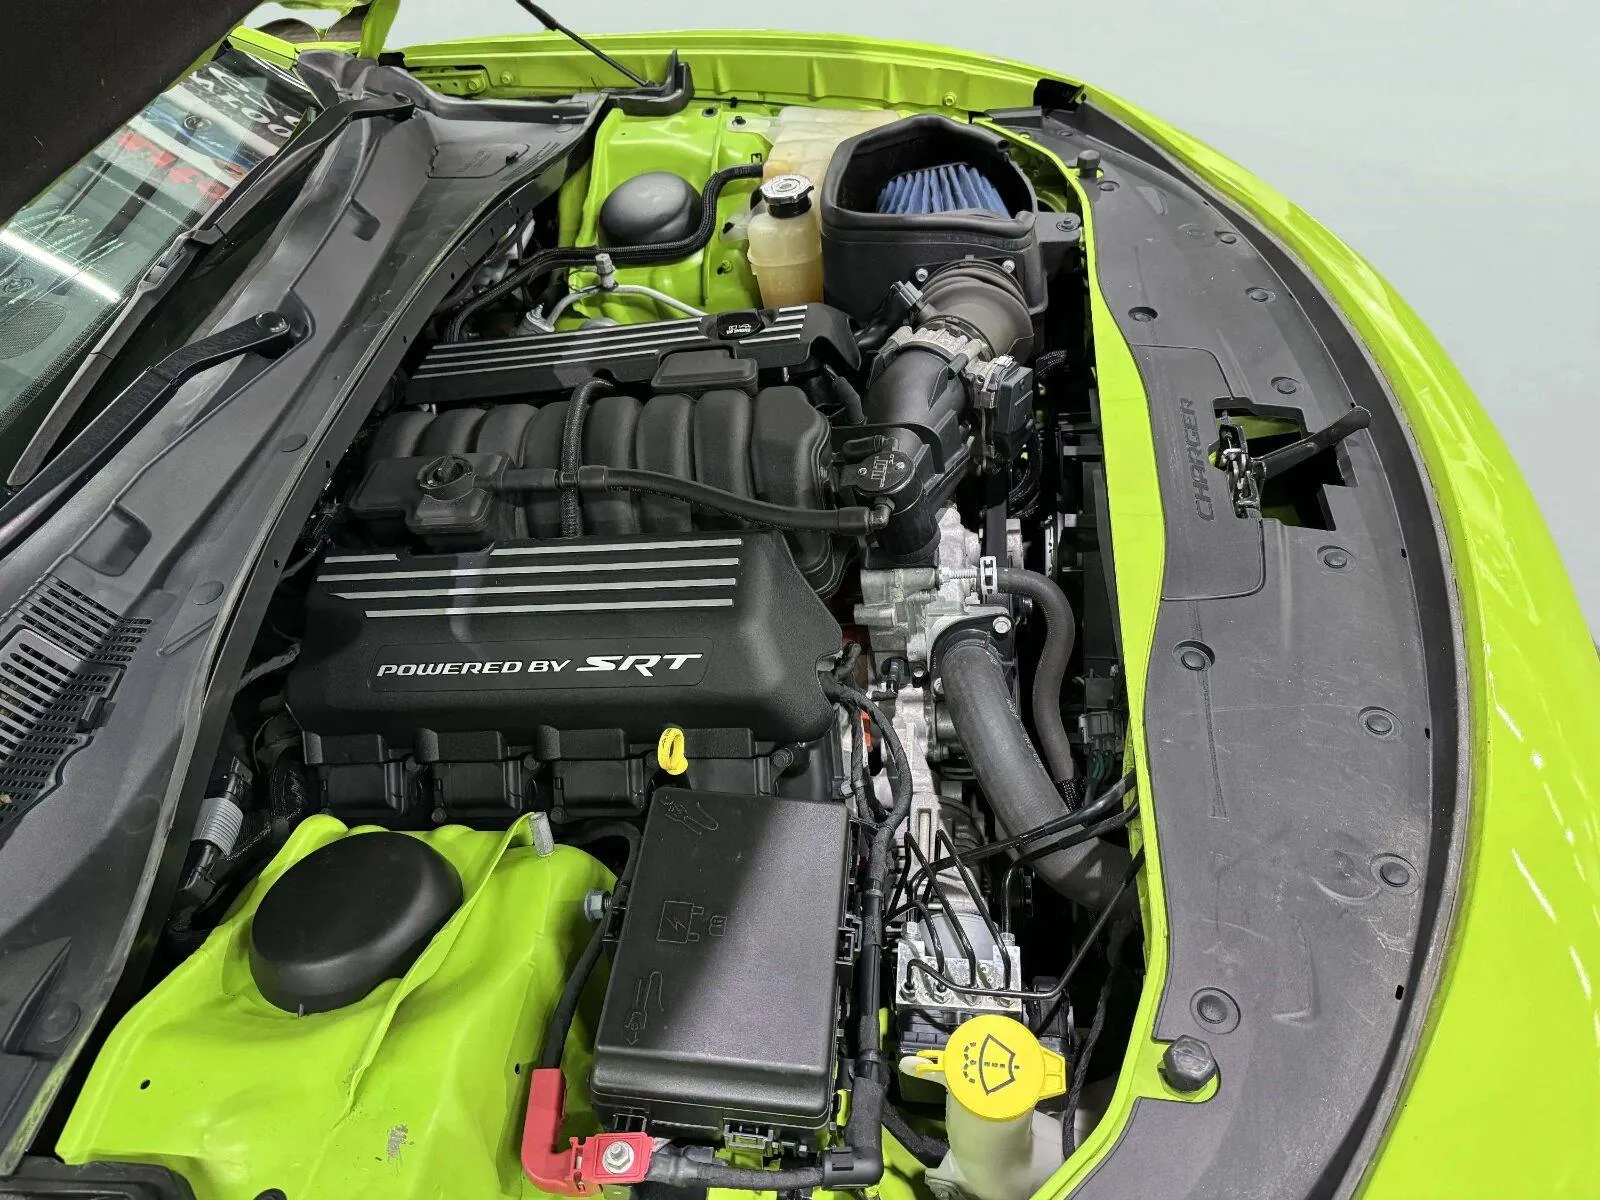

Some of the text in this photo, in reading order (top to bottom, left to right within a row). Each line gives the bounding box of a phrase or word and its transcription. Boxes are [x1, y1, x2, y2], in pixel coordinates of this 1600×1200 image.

[1180, 397, 1214, 520] CHARGER
[376, 653, 703, 677] POWERED BY SRT
